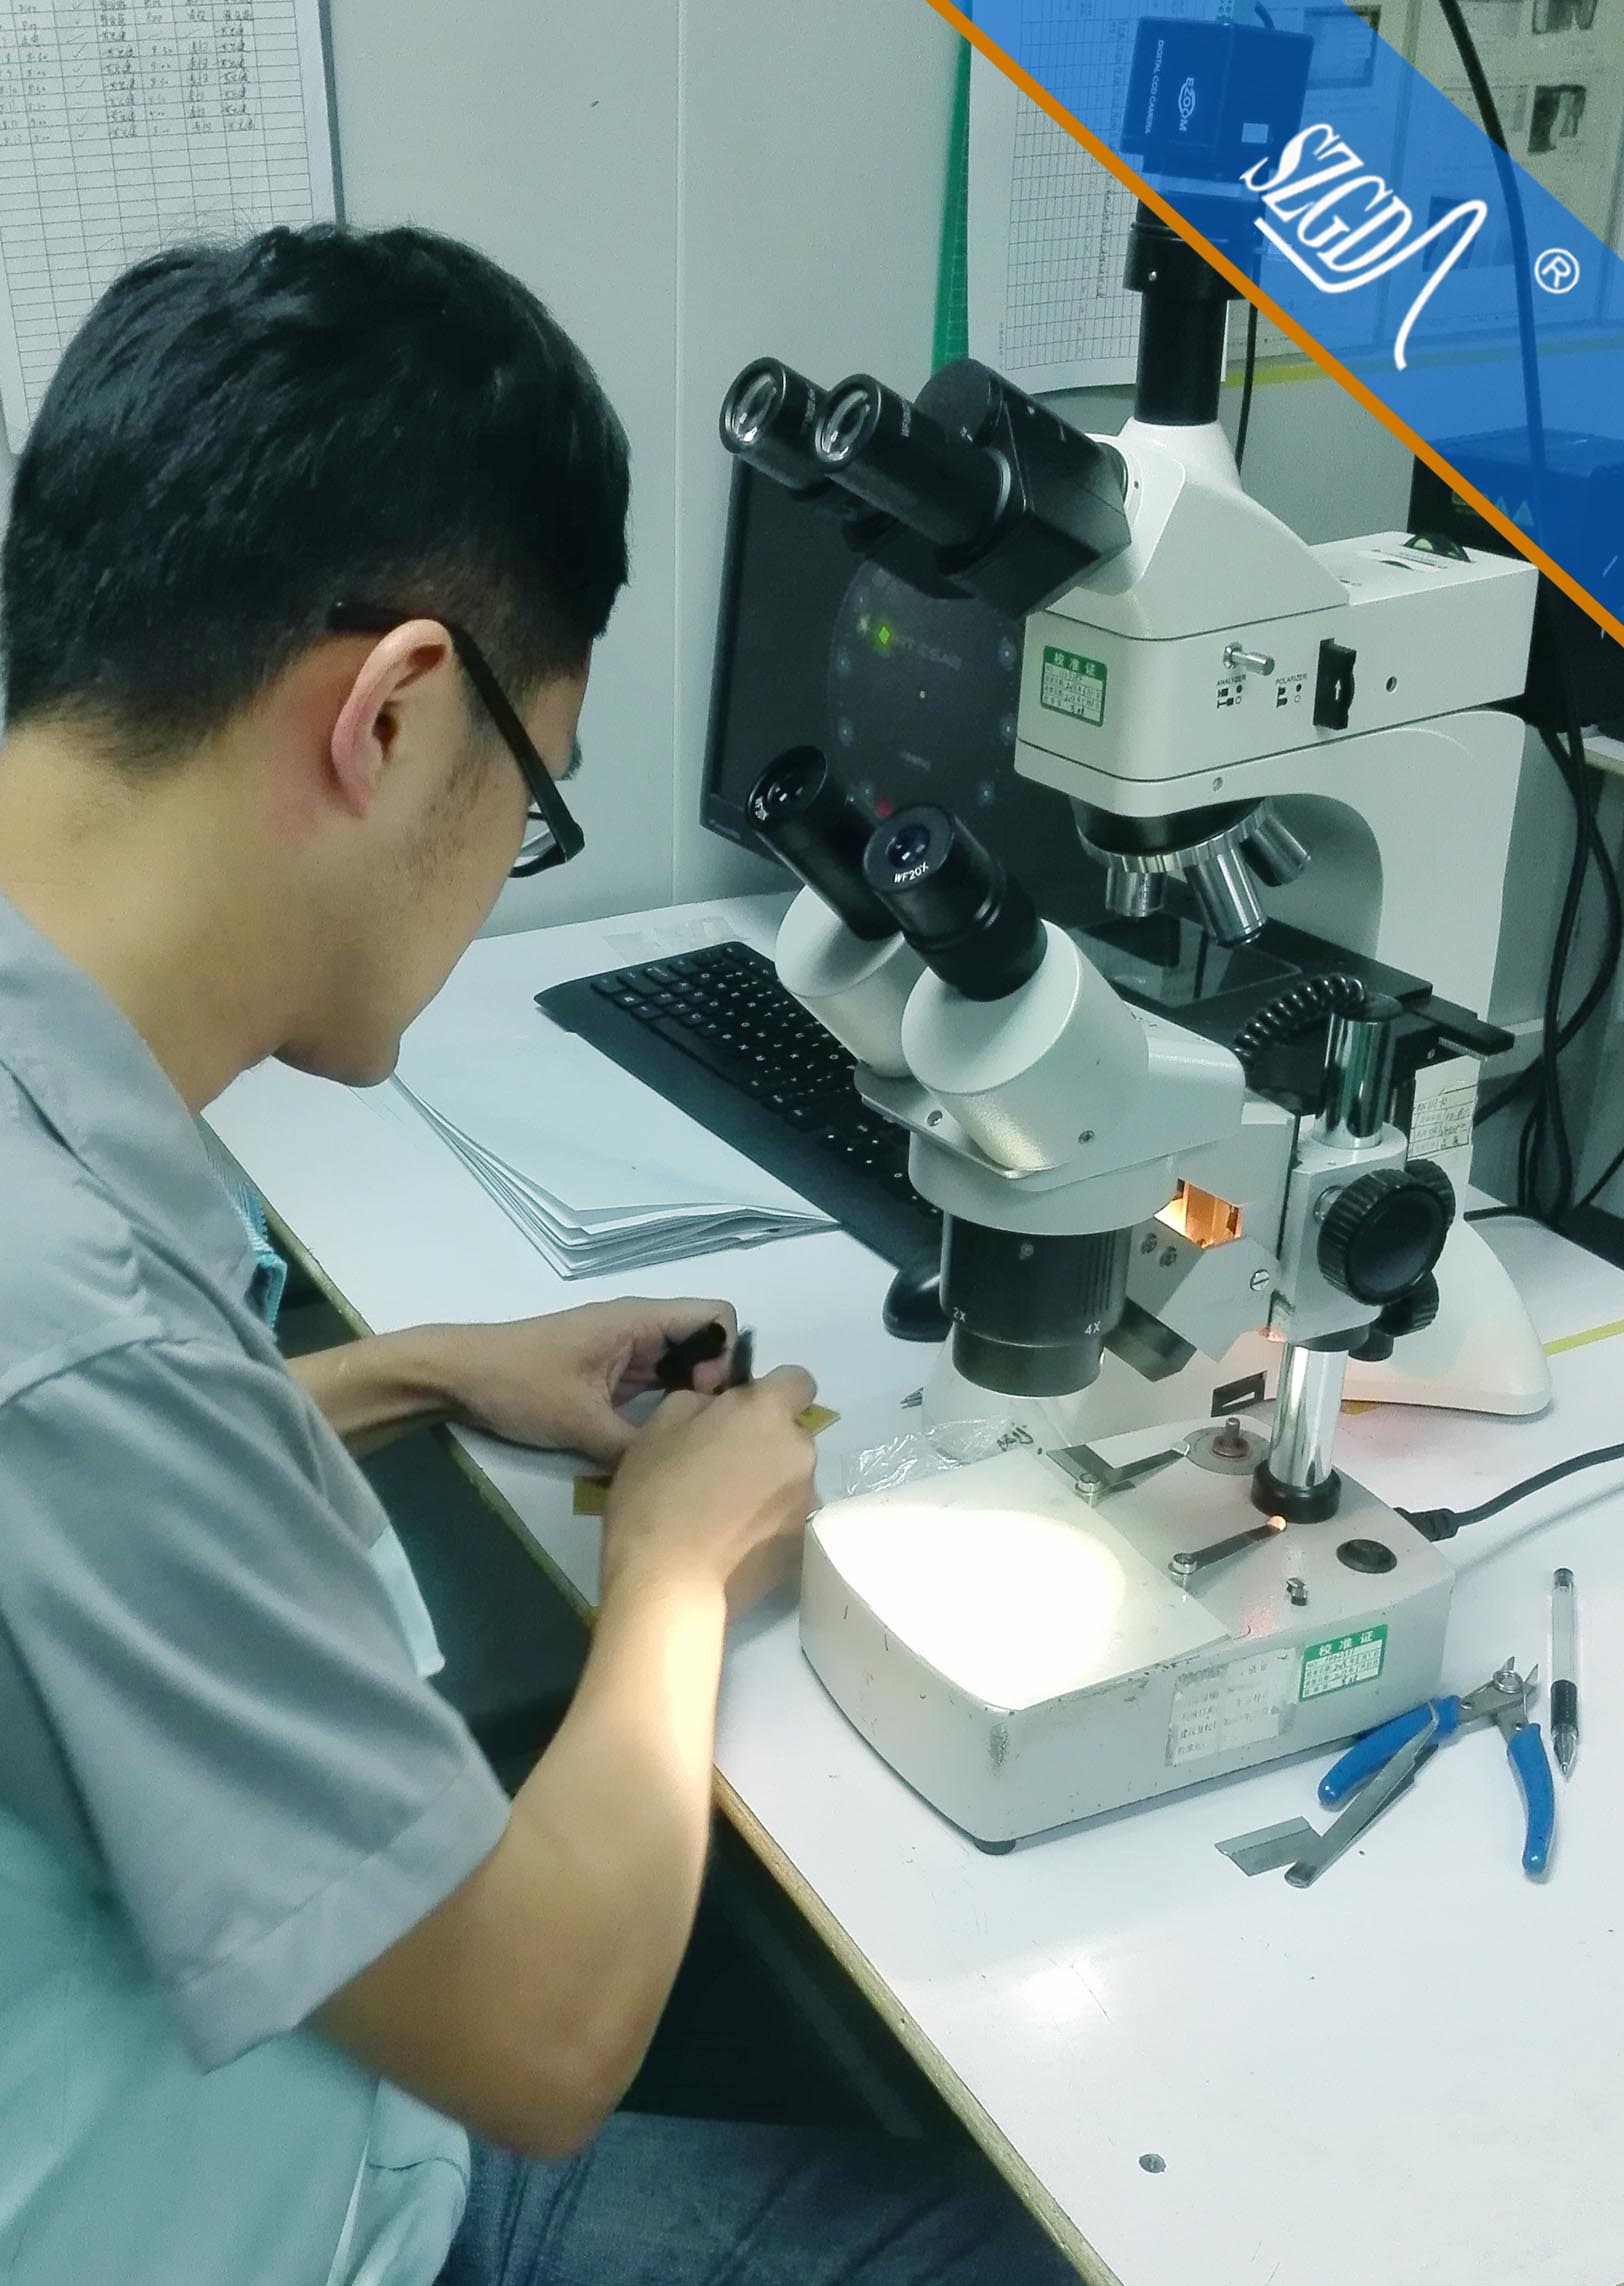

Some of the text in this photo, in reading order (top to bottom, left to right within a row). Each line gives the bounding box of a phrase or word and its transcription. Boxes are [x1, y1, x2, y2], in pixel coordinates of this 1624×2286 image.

[1144, 39, 1165, 135] DIGITAL CCD CAMERA
[1216, 673, 1247, 686] ANALYZER
[1275, 673, 1308, 685] POLARIZER
[894, 861, 930, 884] WF20X
[953, 1307, 966, 1322] 2X
[1085, 1320, 1102, 1335] 4X
[1318, 1629, 1375, 1657] 校准证
